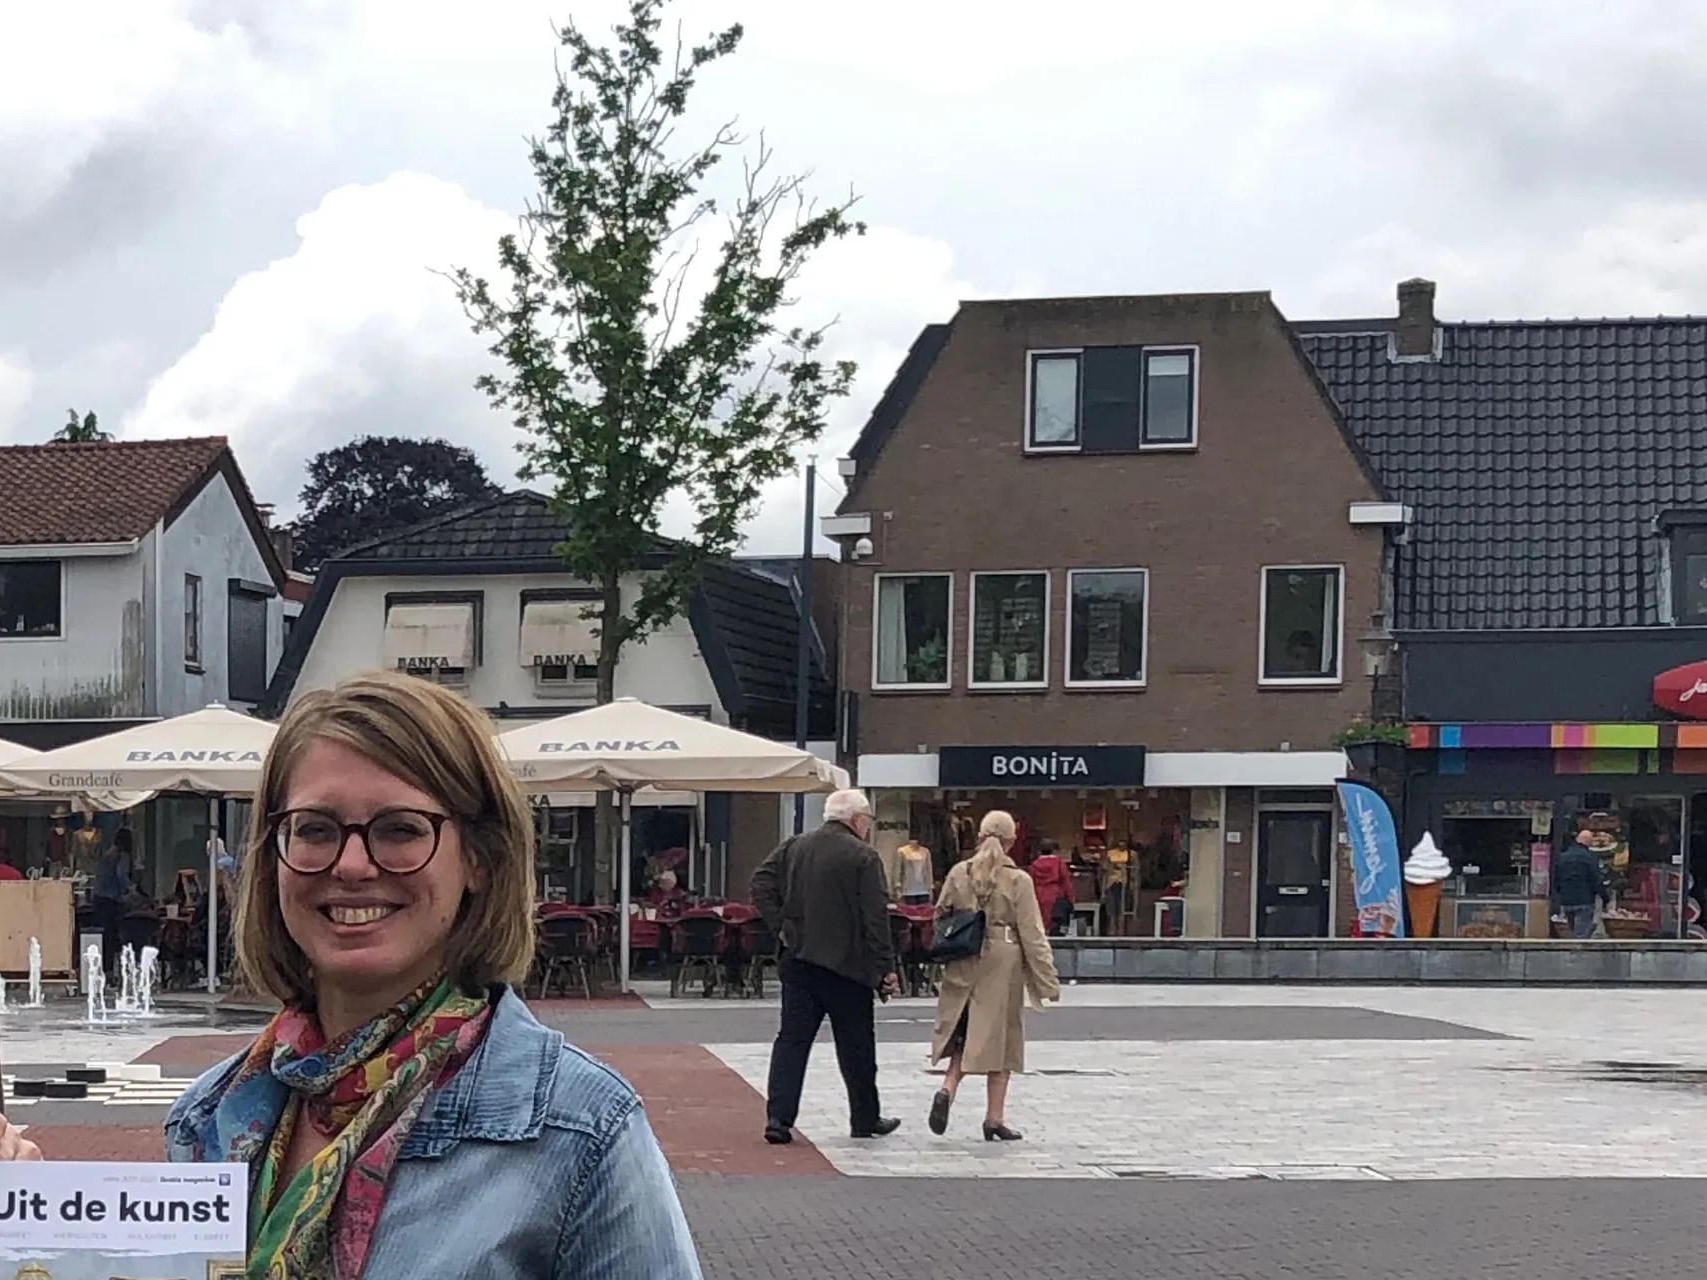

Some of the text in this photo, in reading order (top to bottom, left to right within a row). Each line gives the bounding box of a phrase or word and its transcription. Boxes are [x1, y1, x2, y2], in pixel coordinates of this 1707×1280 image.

[397, 656, 450, 669] BANKA
[533, 654, 588, 667] BANKA
[537, 740, 682, 753] BANKA
[125, 751, 263, 763] BANKA
[48, 771, 123, 788] Grandcafé
[60, 1191, 107, 1222] de
[119, 1191, 230, 1223] kunst
